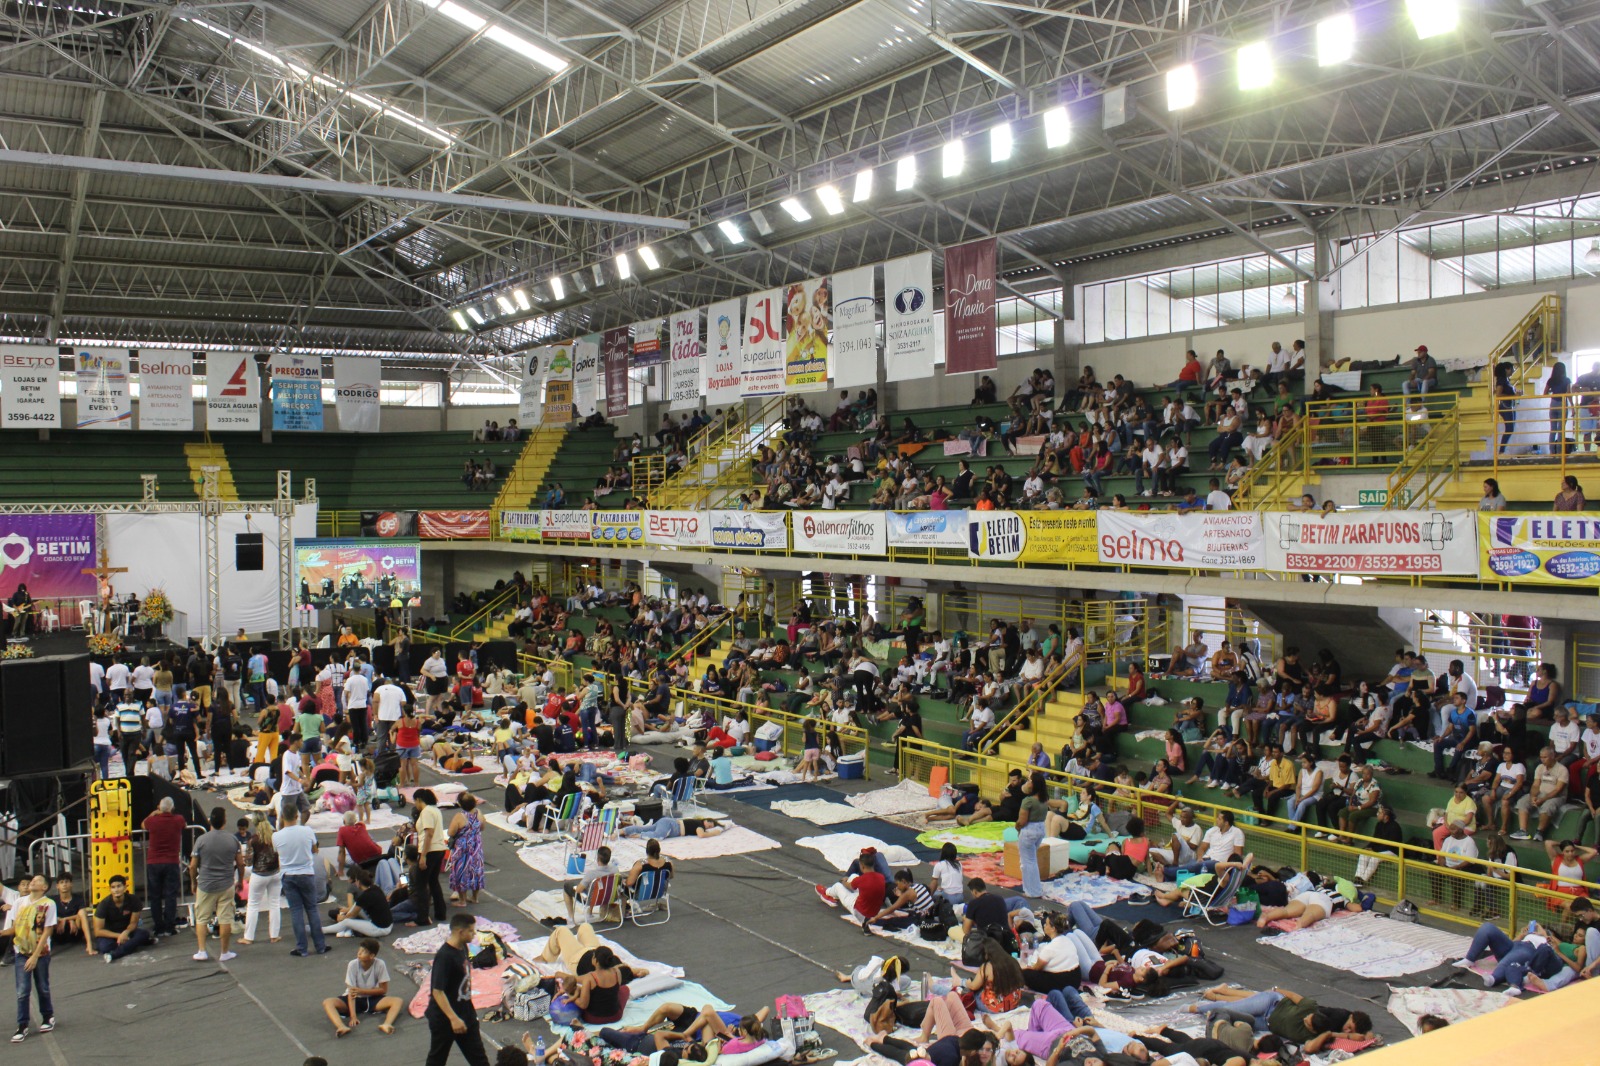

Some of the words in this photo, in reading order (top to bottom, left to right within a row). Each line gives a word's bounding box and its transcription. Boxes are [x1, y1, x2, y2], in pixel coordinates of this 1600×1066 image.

[950, 274, 992, 295] Dona
[946, 297, 995, 319] Maria
[677, 320, 694, 337] Tia
[672, 339, 700, 361] Cida
[4, 355, 55, 365] BETTO
[716, 362, 733, 372] LOJAS
[141, 361, 191, 375] selma
[338, 390, 378, 398] RODRIGO
[621, 513, 639, 522] BETIM
[650, 515, 698, 532] BETTO
[1203, 516, 1252, 525] AVIAMENTOS
[987, 517, 1019, 536] ELETRO
[1203, 529, 1251, 538] ARTESANATO
[1301, 524, 1339, 544] BETIM
[1342, 523, 1420, 544] PARAFUSOS
[37, 542, 90, 555] BETIM
[989, 534, 1020, 555] BETIM
[1102, 530, 1184, 562] selma
[1220, 556, 1256, 564] 3532-1869
[1557, 562, 1599, 573] 3532-3432
